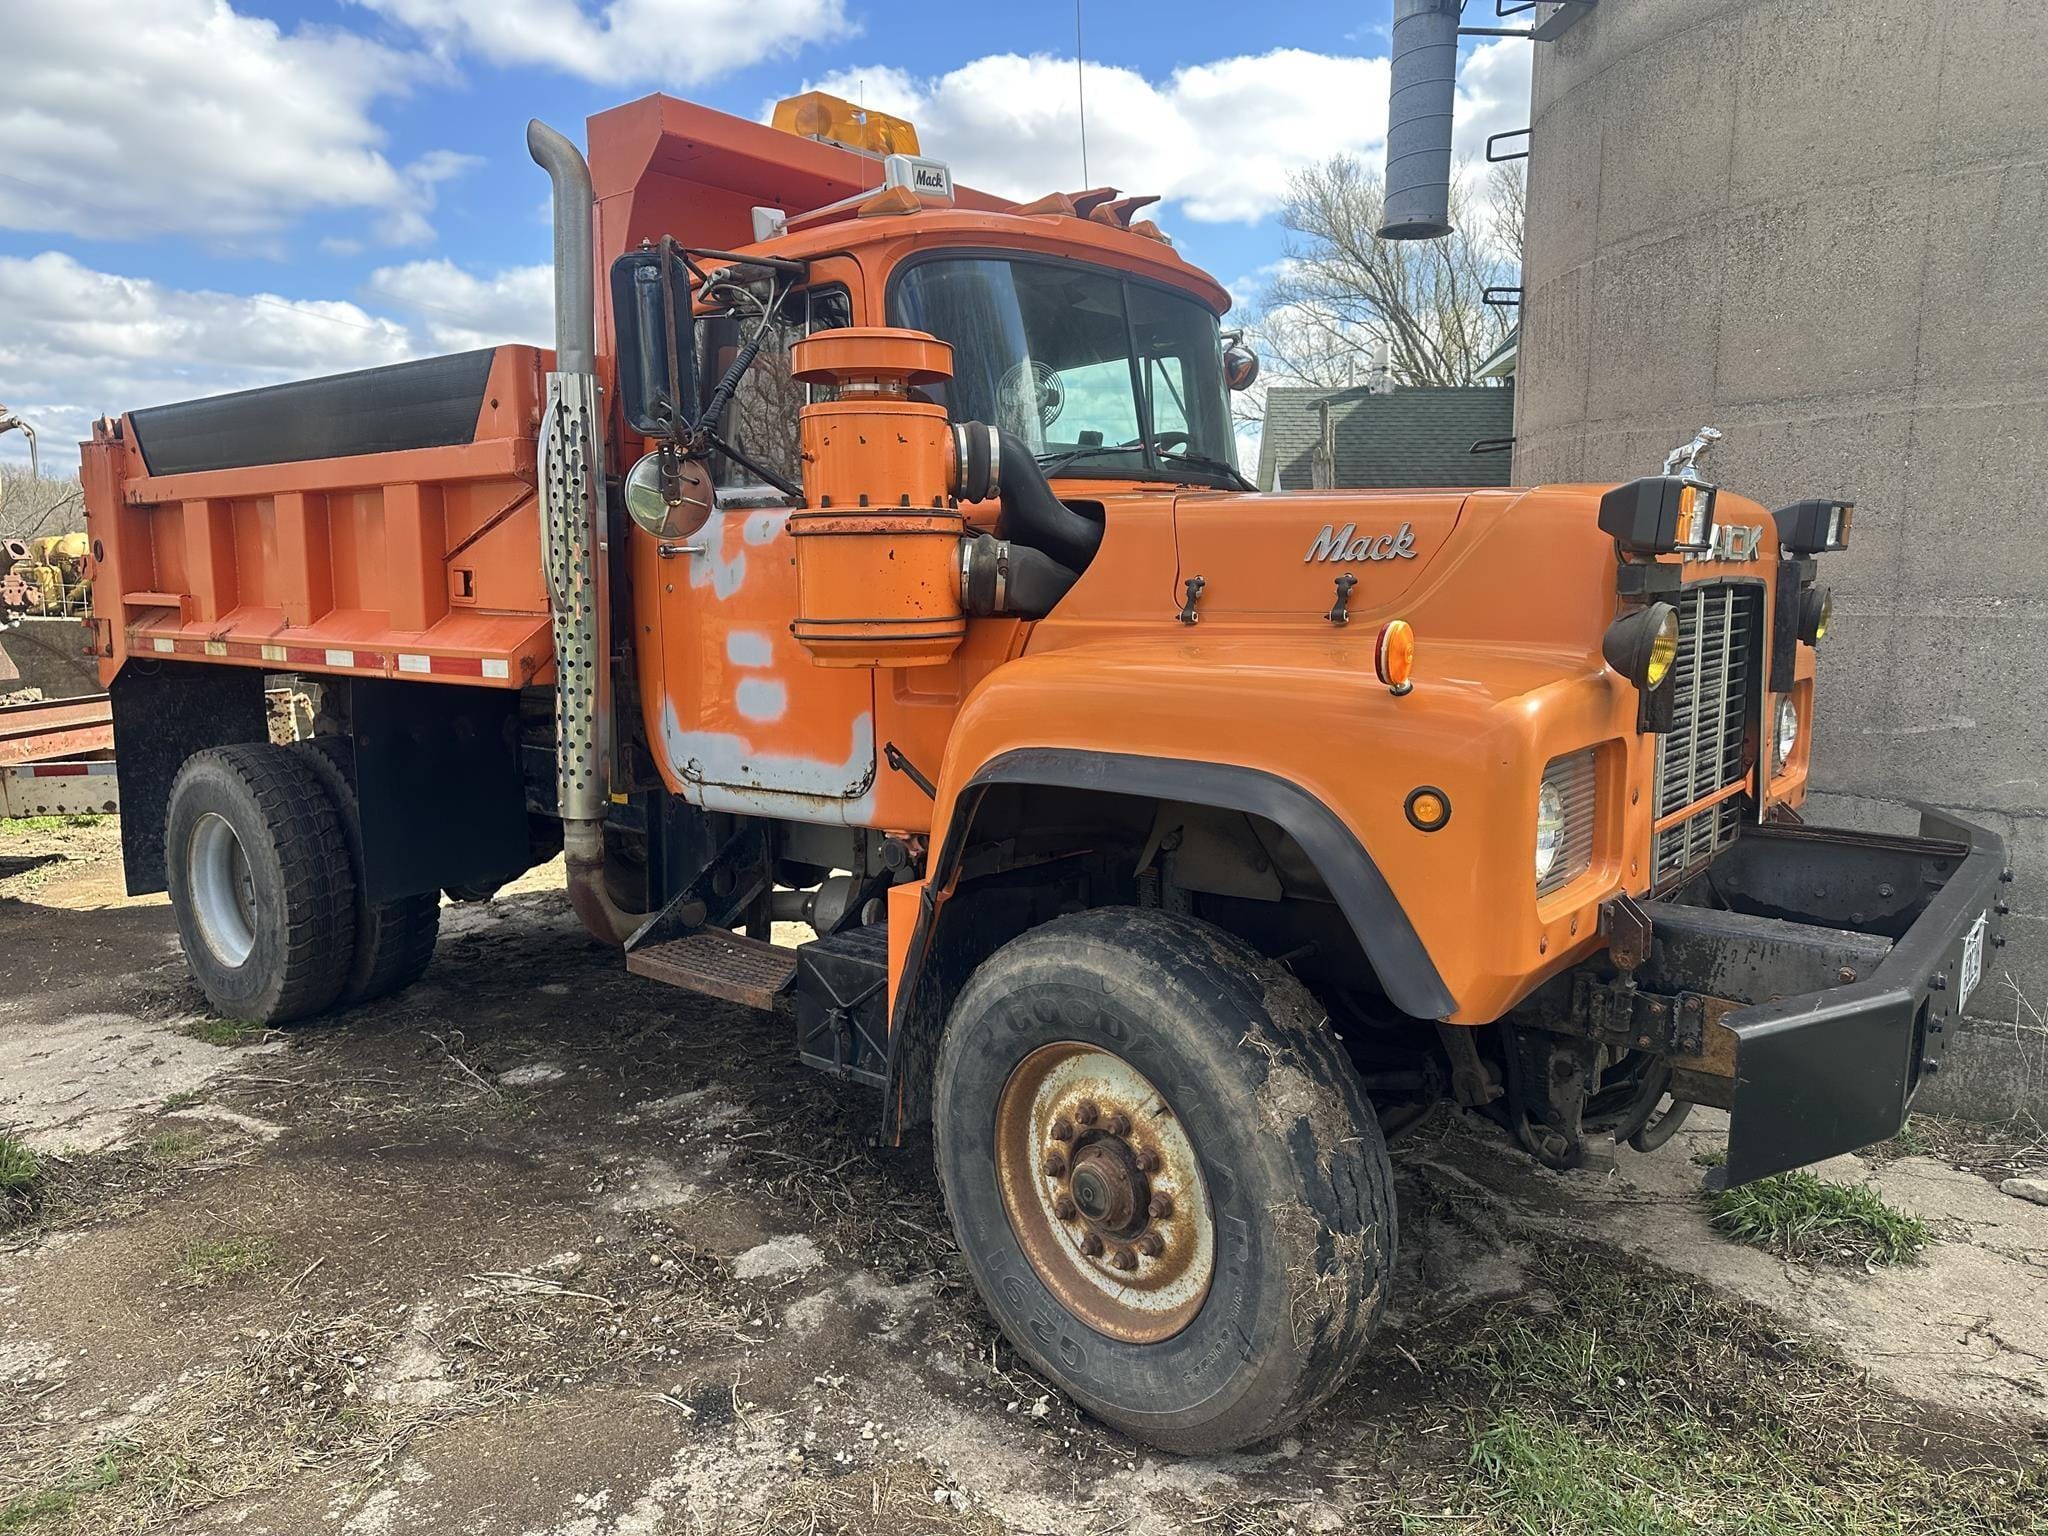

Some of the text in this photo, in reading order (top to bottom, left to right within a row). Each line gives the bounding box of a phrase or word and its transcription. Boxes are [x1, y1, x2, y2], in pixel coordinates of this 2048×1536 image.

[916, 170, 943, 188] Mack
[1304, 522, 1417, 562] Mack
[1684, 523, 1763, 562] ACK
